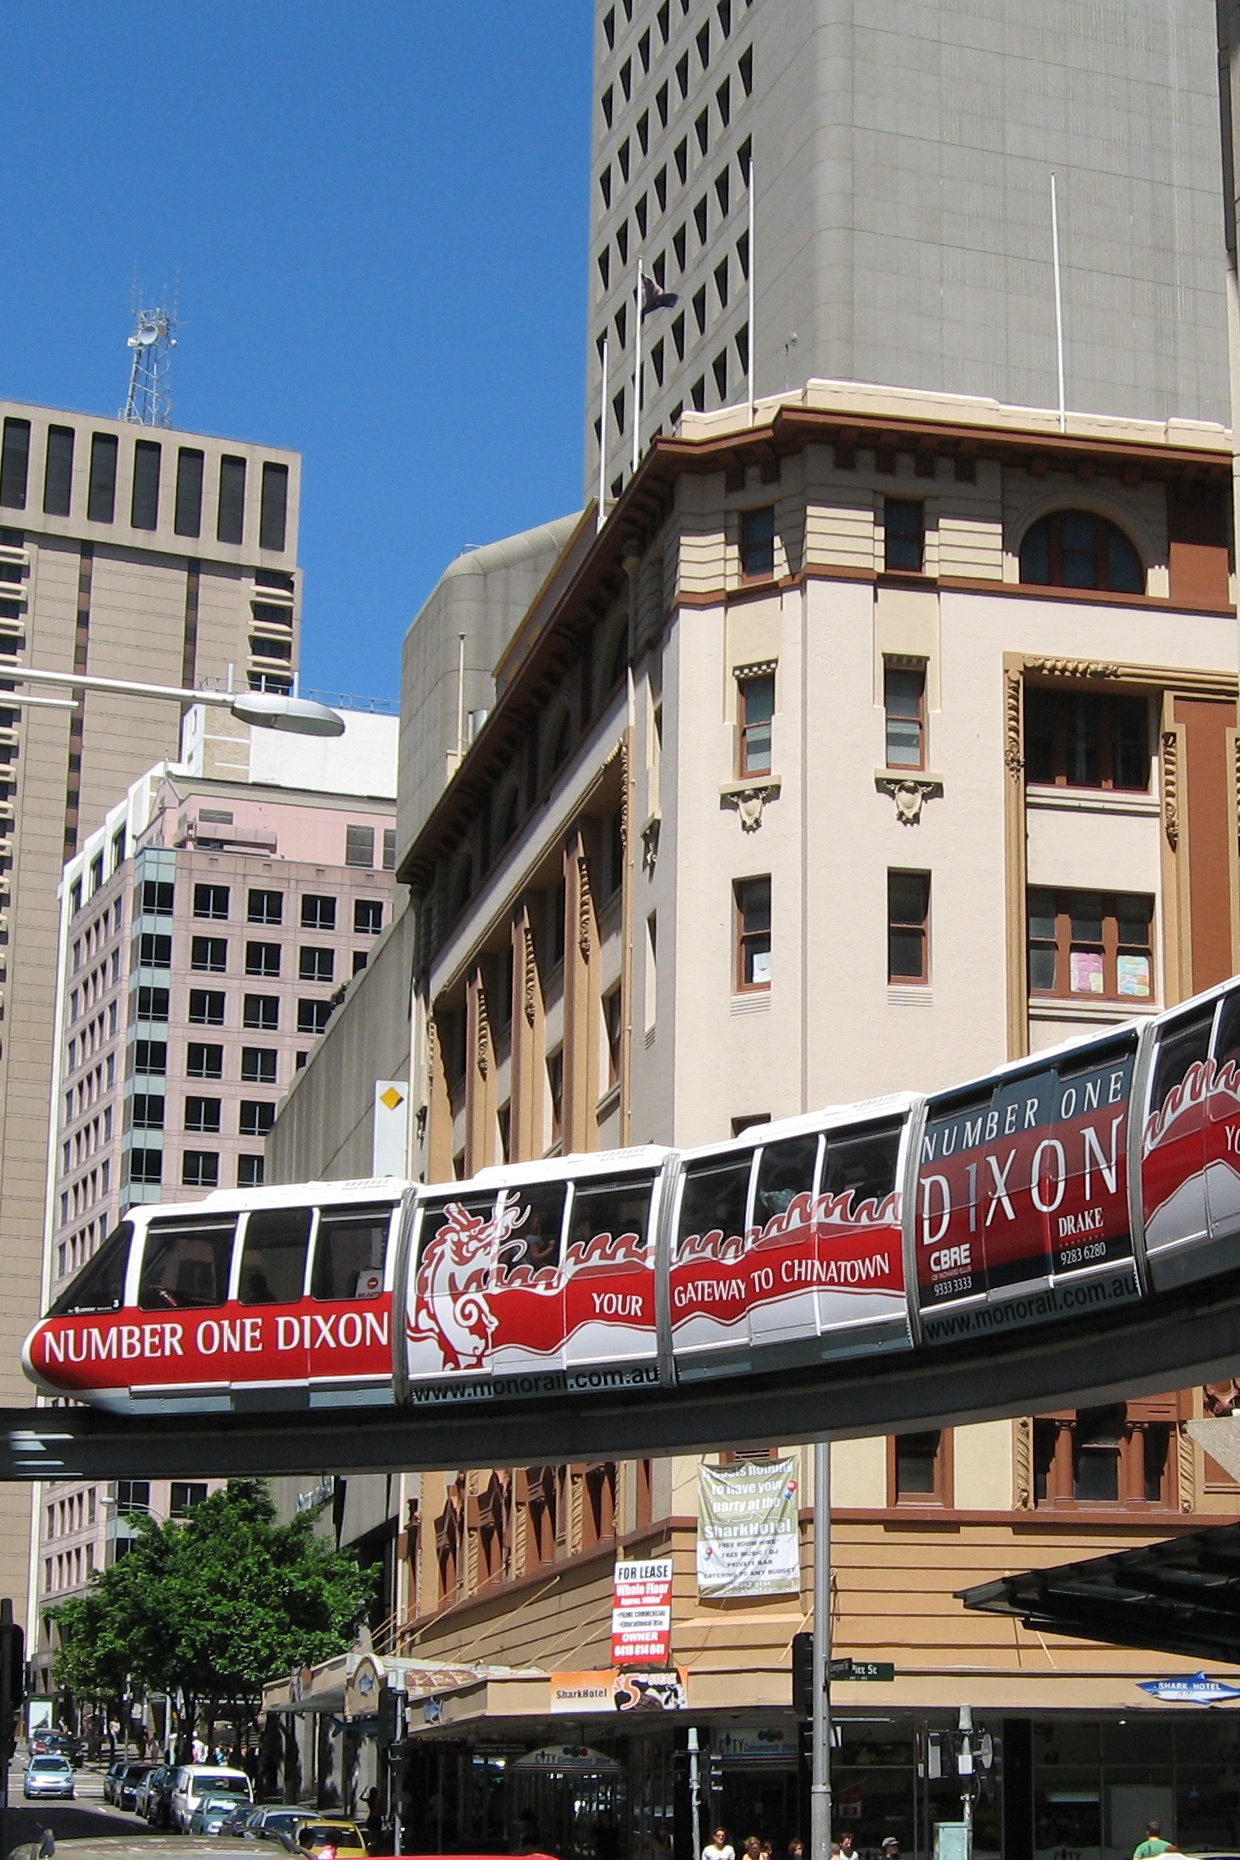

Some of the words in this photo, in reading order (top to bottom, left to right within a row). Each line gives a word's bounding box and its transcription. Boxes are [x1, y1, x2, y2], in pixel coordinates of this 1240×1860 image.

[921, 1098, 1040, 1164] NUMBER
[1061, 1071, 1125, 1120] ONE
[919, 1114, 1125, 1246] DIXON
[1058, 1207, 1104, 1238] DRAKE
[929, 1243, 972, 1272] CBRE
[1060, 1247, 1082, 1265] 9283
[1083, 1242, 1107, 1259] 6280
[674, 1278, 747, 1307] GATEWAY
[750, 1267, 774, 1292] TO
[781, 1252, 891, 1284] CHINATOWN
[933, 1280, 953, 1297] 9333
[953, 1275, 972, 1293] 3333
[592, 1292, 643, 1317] YOUR
[926, 1278, 1136, 1340] www.monorail.com.au
[43, 1322, 184, 1364] NUMBER
[196, 1317, 263, 1355] ONE
[275, 1311, 388, 1350] DIXON
[412, 1368, 660, 1402] www.monorail.com.au
[712, 1483, 724, 1496] to
[727, 1483, 756, 1495] have
[758, 1479, 784, 1494] your
[713, 1500, 746, 1513] party
[747, 1499, 760, 1511] at
[762, 1497, 781, 1508] the
[704, 1518, 791, 1539] SharkHotel
[618, 1566, 637, 1580] FOR
[640, 1564, 668, 1579] LEASE
[616, 1584, 645, 1596] Whole
[646, 1582, 669, 1594] Floor
[621, 1632, 658, 1642] OWNER
[867, 1664, 878, 1675] St
[556, 1688, 608, 1699] SharkHotel
[1158, 1682, 1188, 1690] SHARK
[1193, 1682, 1222, 1690] HOTEL
[719, 1735, 744, 1753] CITY
[535, 1751, 557, 1764] CITY
